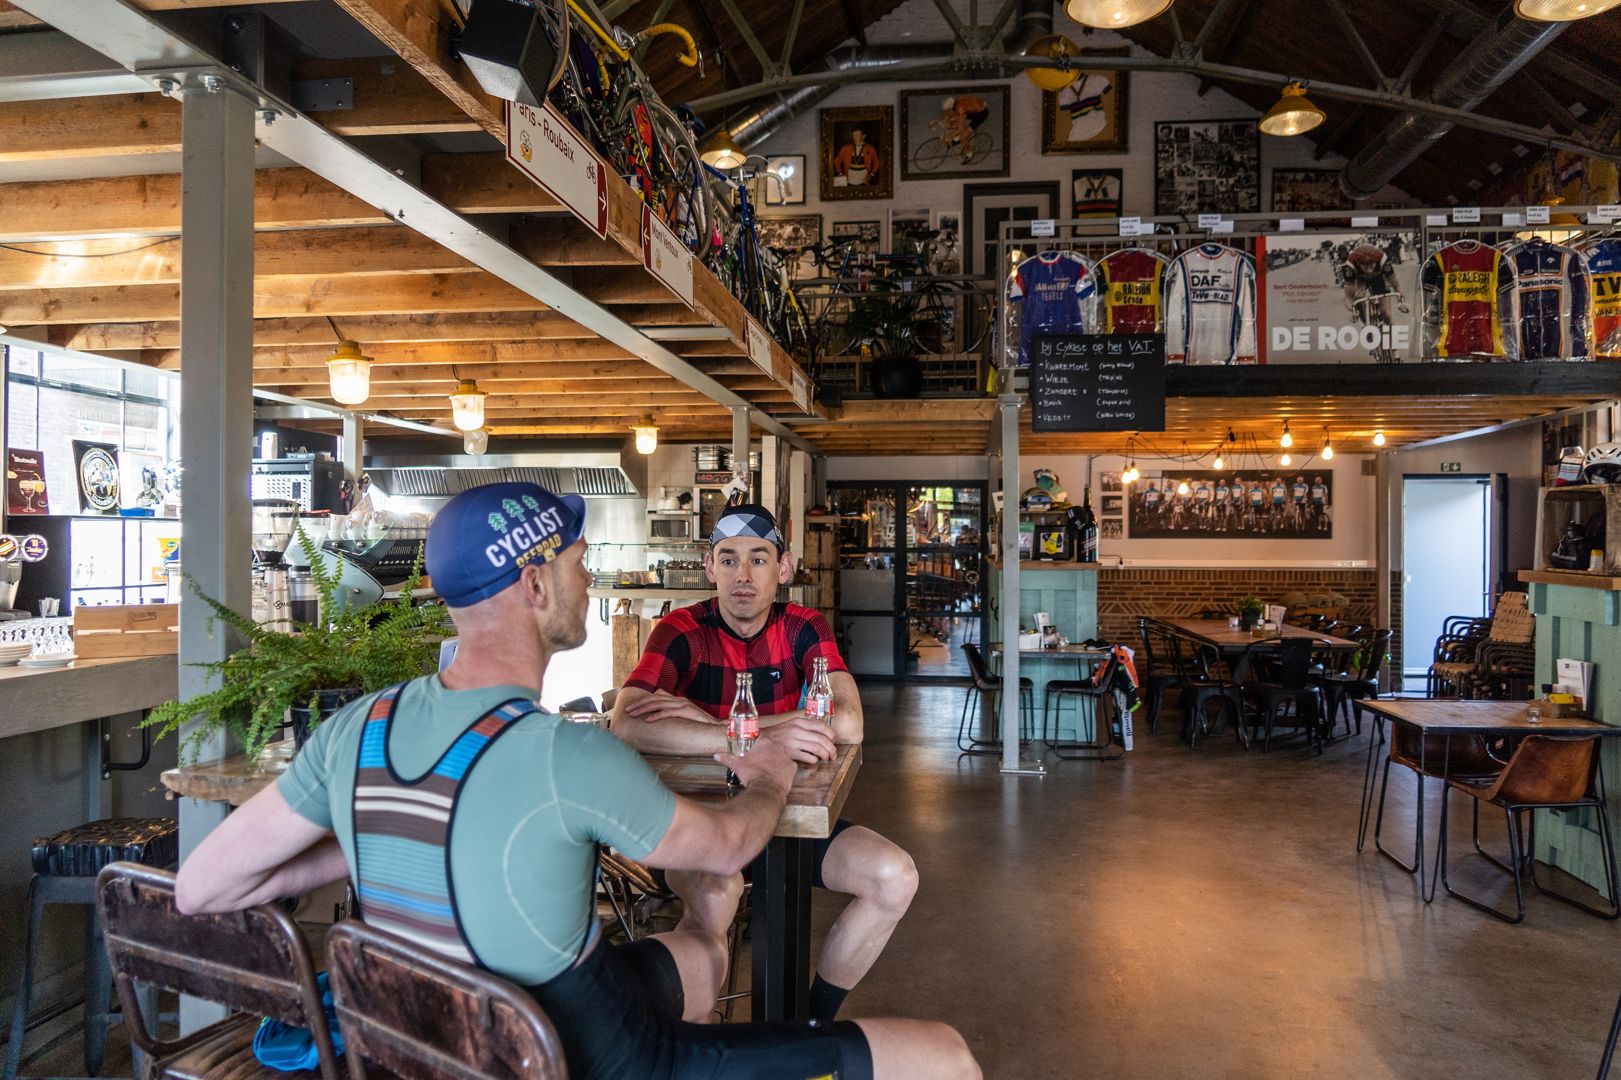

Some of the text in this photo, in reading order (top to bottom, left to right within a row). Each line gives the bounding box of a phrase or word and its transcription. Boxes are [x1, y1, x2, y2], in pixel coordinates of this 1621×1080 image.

[513, 101, 536, 127] aris
[543, 118, 575, 164] Roubaix
[1191, 275, 1221, 287] DAF
[1518, 278, 1562, 287] Panasonic
[1092, 343, 1103, 352] op
[1107, 340, 1122, 352] het
[1272, 326, 1311, 351] DE
[485, 506, 564, 568] CYCLIST
